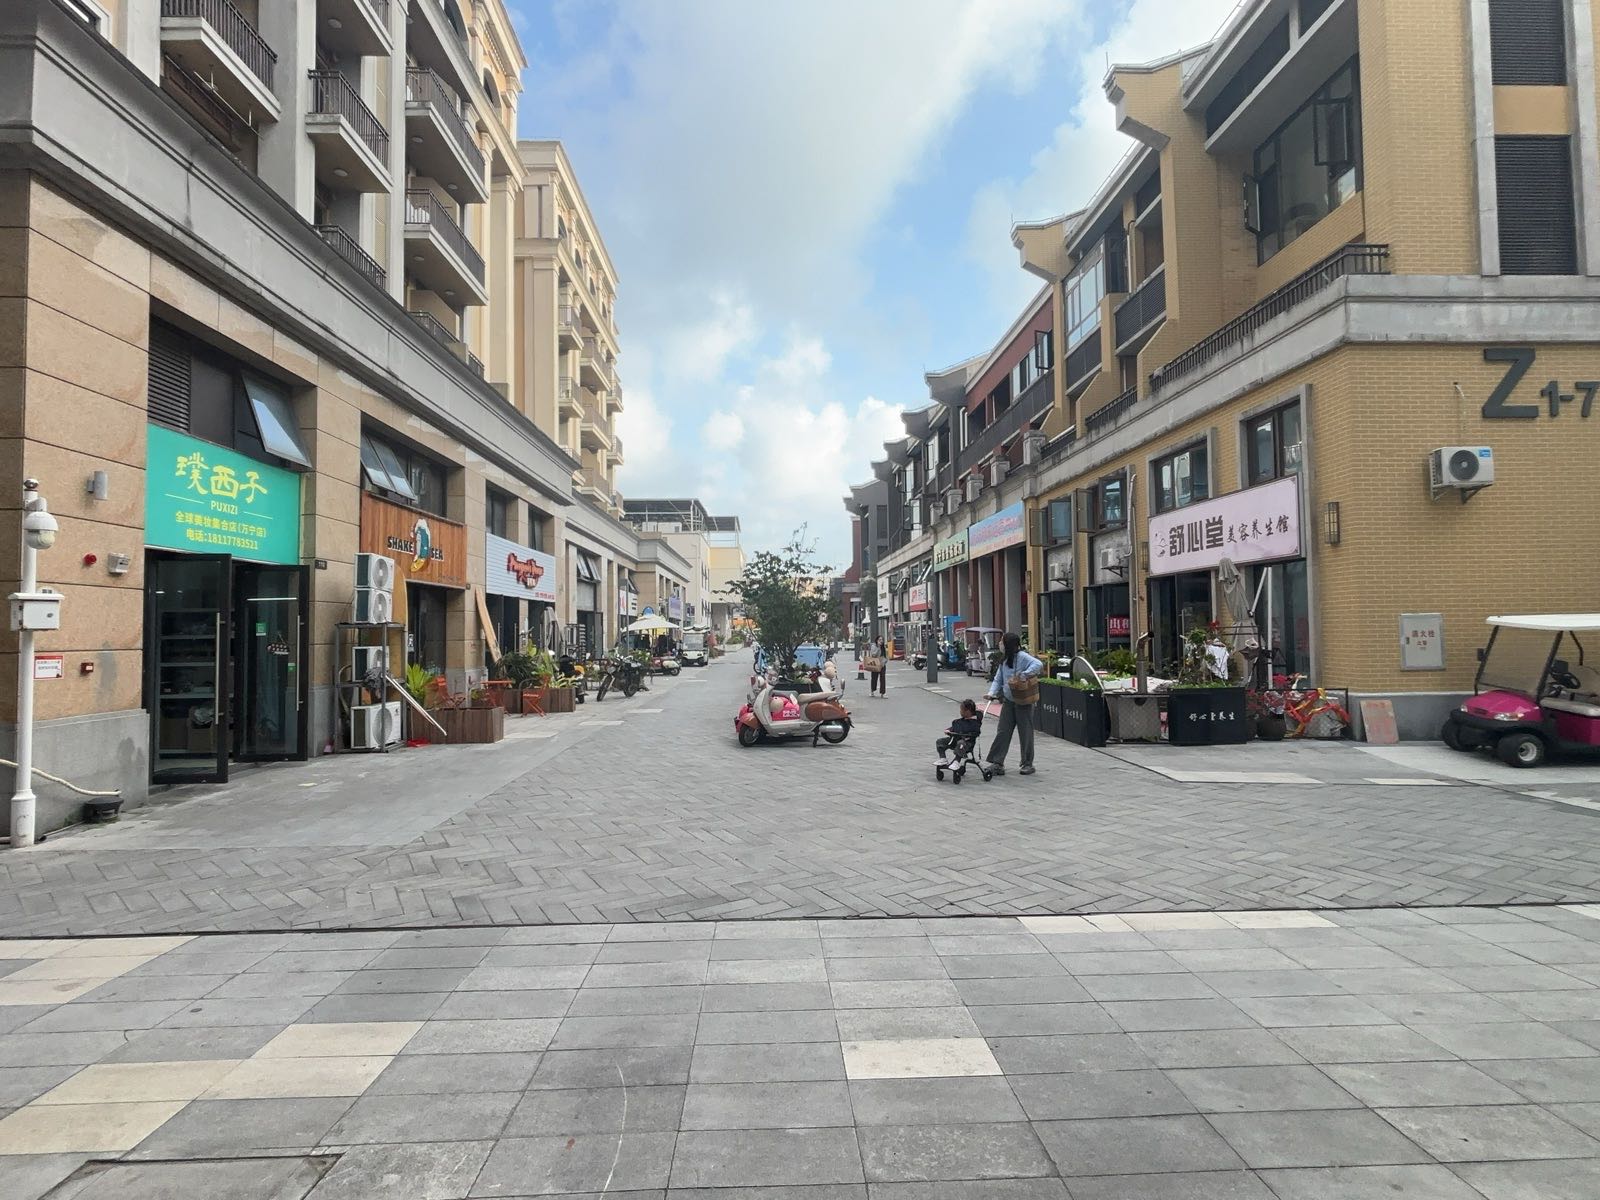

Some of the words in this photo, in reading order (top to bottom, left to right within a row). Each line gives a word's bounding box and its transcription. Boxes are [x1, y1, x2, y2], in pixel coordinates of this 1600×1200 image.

[175, 452, 268, 503] 璞西子
[210, 500, 238, 515] PUXIZI
[387, 536, 414, 554] SHAKE
[430, 547, 445, 562] SEA
[1169, 515, 1223, 557] 舒心堂
